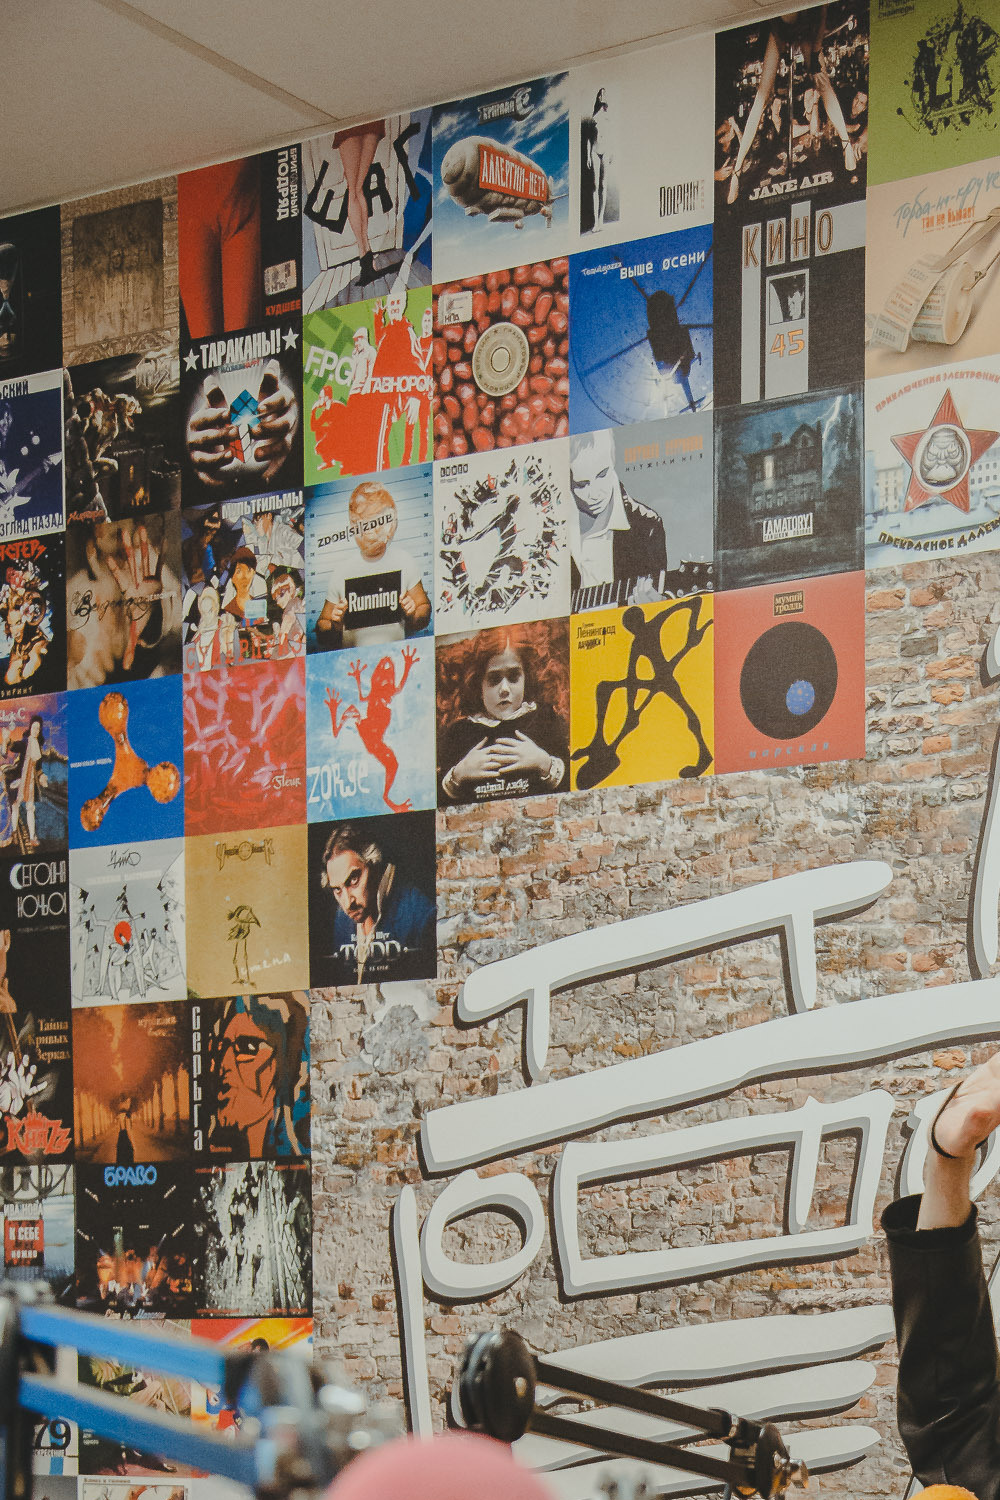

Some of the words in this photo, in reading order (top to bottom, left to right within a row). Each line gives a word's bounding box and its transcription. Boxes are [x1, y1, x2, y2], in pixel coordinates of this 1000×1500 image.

[277, 150, 289, 221] ПОДРЯД
[749, 179, 798, 201] JANE
[799, 171, 835, 189] AIR
[743, 211, 834, 269] КИНО
[265, 299, 301, 316] ХУДШЕЕ
[199, 328, 282, 370] ТАРАКАНЫ!
[769, 329, 806, 359] 45
[31, 513, 64, 532] НАЗАД
[878, 531, 955, 552] ПРЕКРАСНОЕ
[348, 586, 399, 613] Running
[104, 1165, 158, 1187] БРАВО
